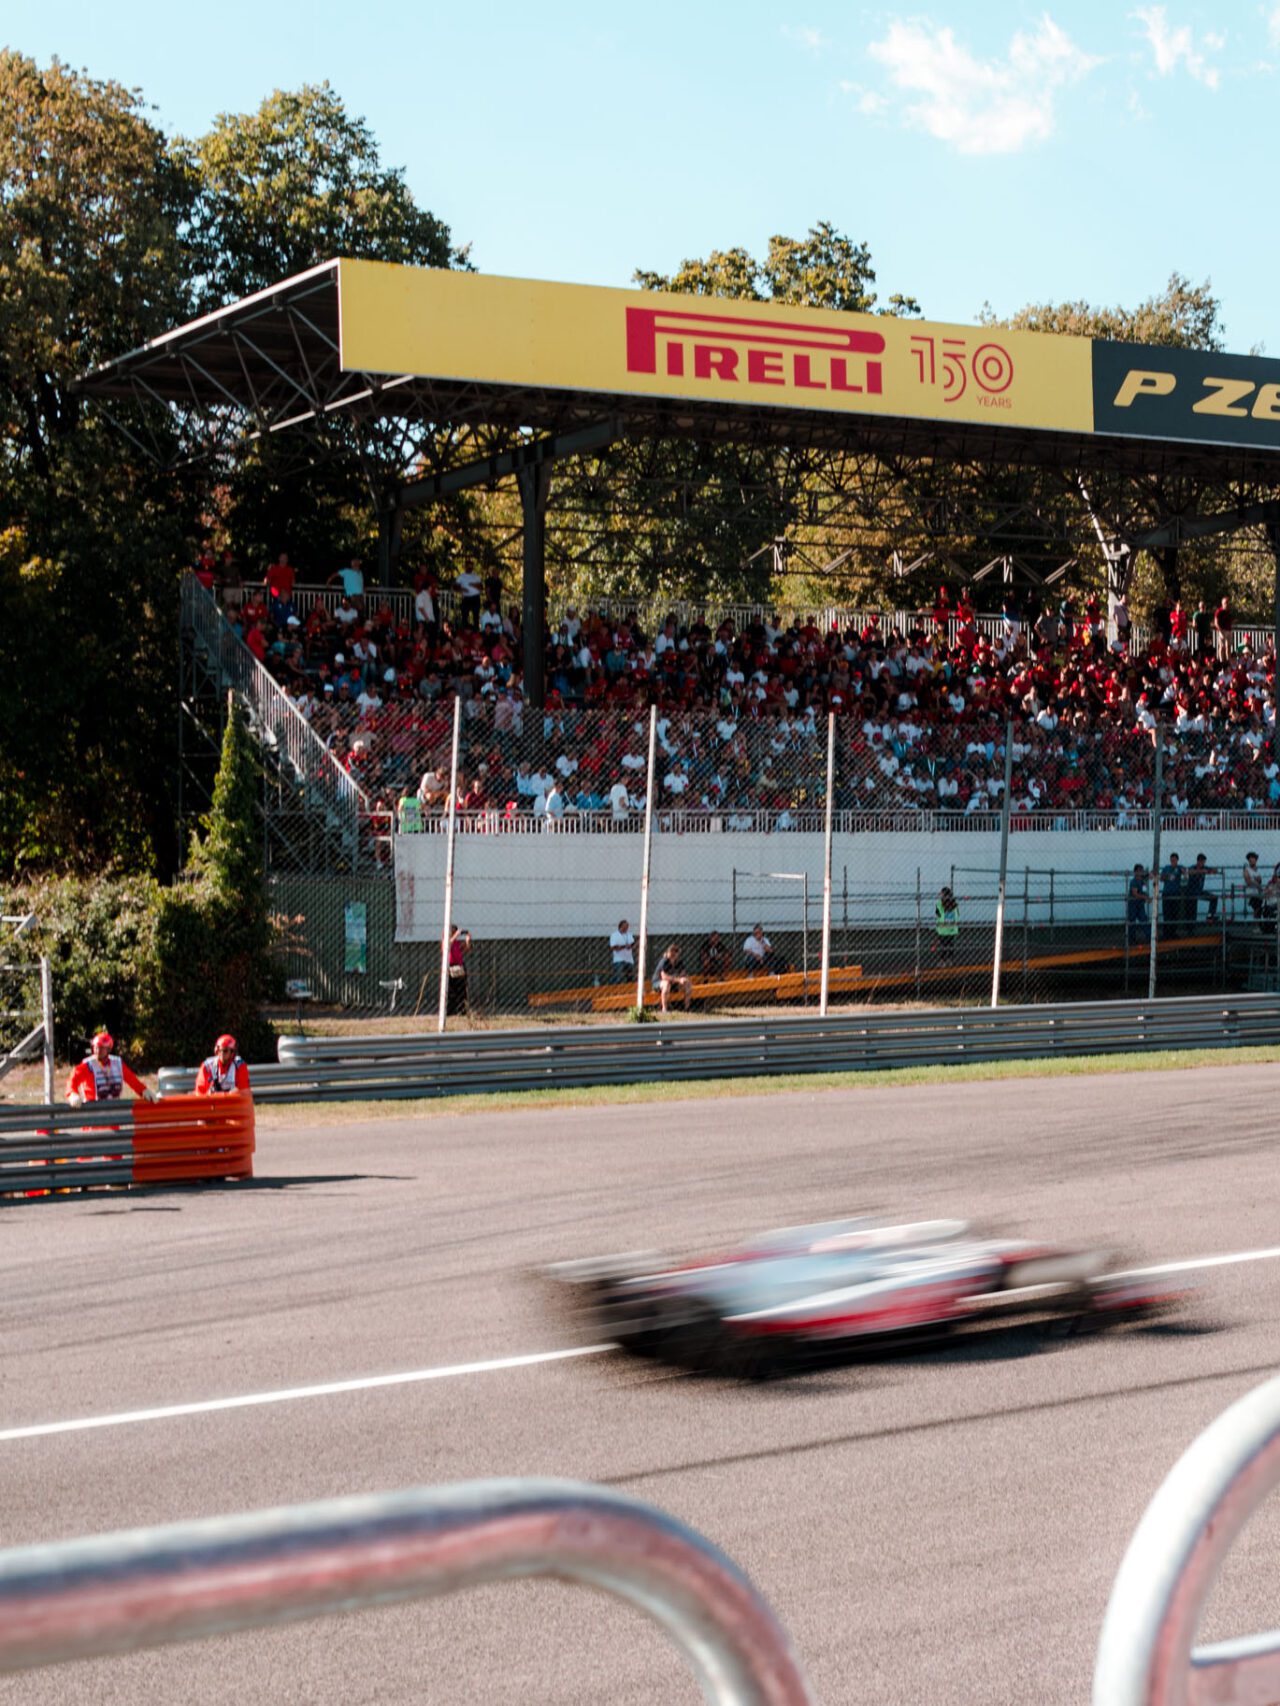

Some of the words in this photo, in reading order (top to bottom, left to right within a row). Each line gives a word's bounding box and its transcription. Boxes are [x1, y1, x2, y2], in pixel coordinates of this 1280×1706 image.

[625, 306, 886, 395] PIRELLI
[910, 335, 1015, 403] 150
[975, 396, 1013, 409] YEARS
[1113, 370, 1177, 407] P
